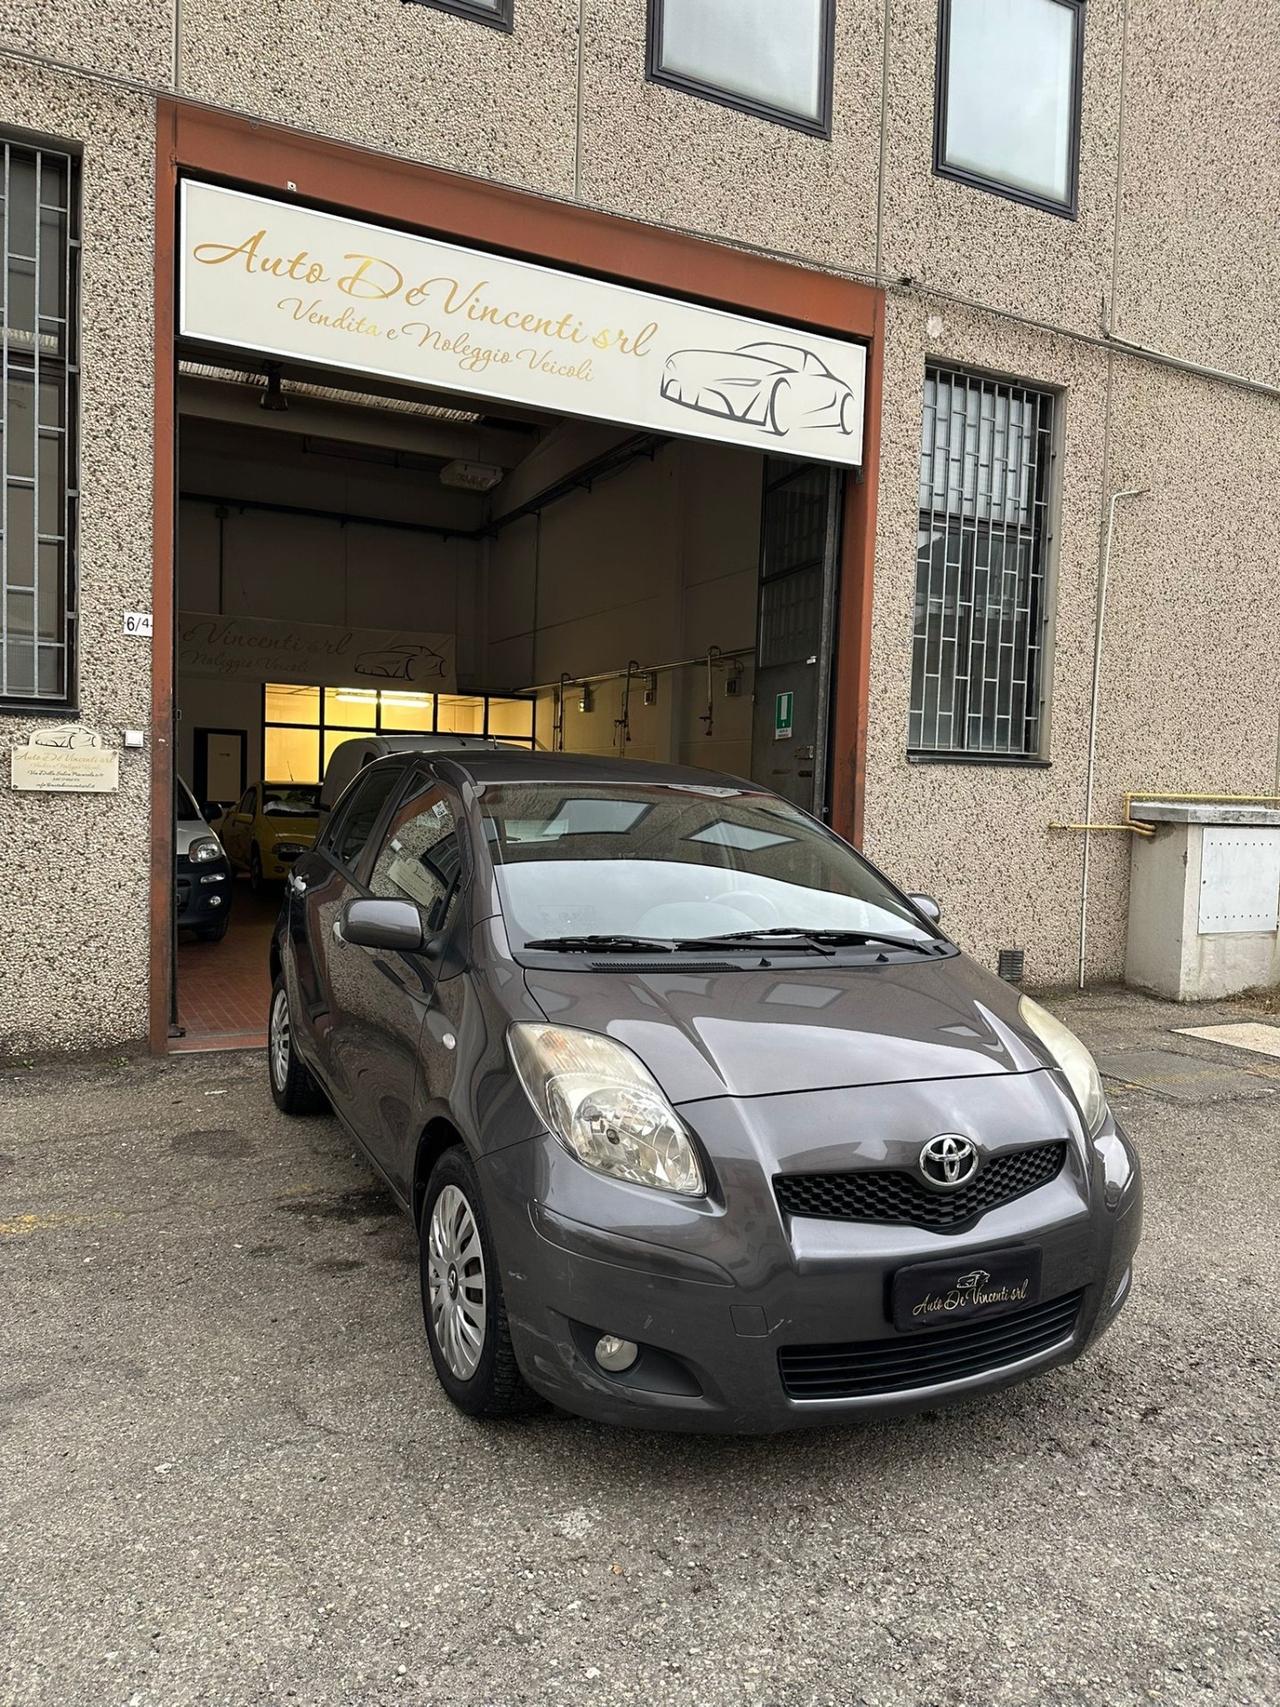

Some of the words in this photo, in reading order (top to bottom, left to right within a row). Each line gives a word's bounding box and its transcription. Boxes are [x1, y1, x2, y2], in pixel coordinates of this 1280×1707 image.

[193, 229, 330, 284] Auto
[337, 253, 430, 306] De
[418, 277, 587, 344] Vincenti
[591, 322, 659, 358] srl
[277, 297, 381, 337] Vendita
[386, 326, 399, 341] e
[401, 322, 513, 373] Noleggio
[515, 348, 595, 383] Veicoli
[191, 620, 304, 652] Vincenti
[912, 1293, 943, 1316] Auto
[964, 1284, 1009, 1305] Vincenti
[1010, 1278, 1029, 1301] srl
